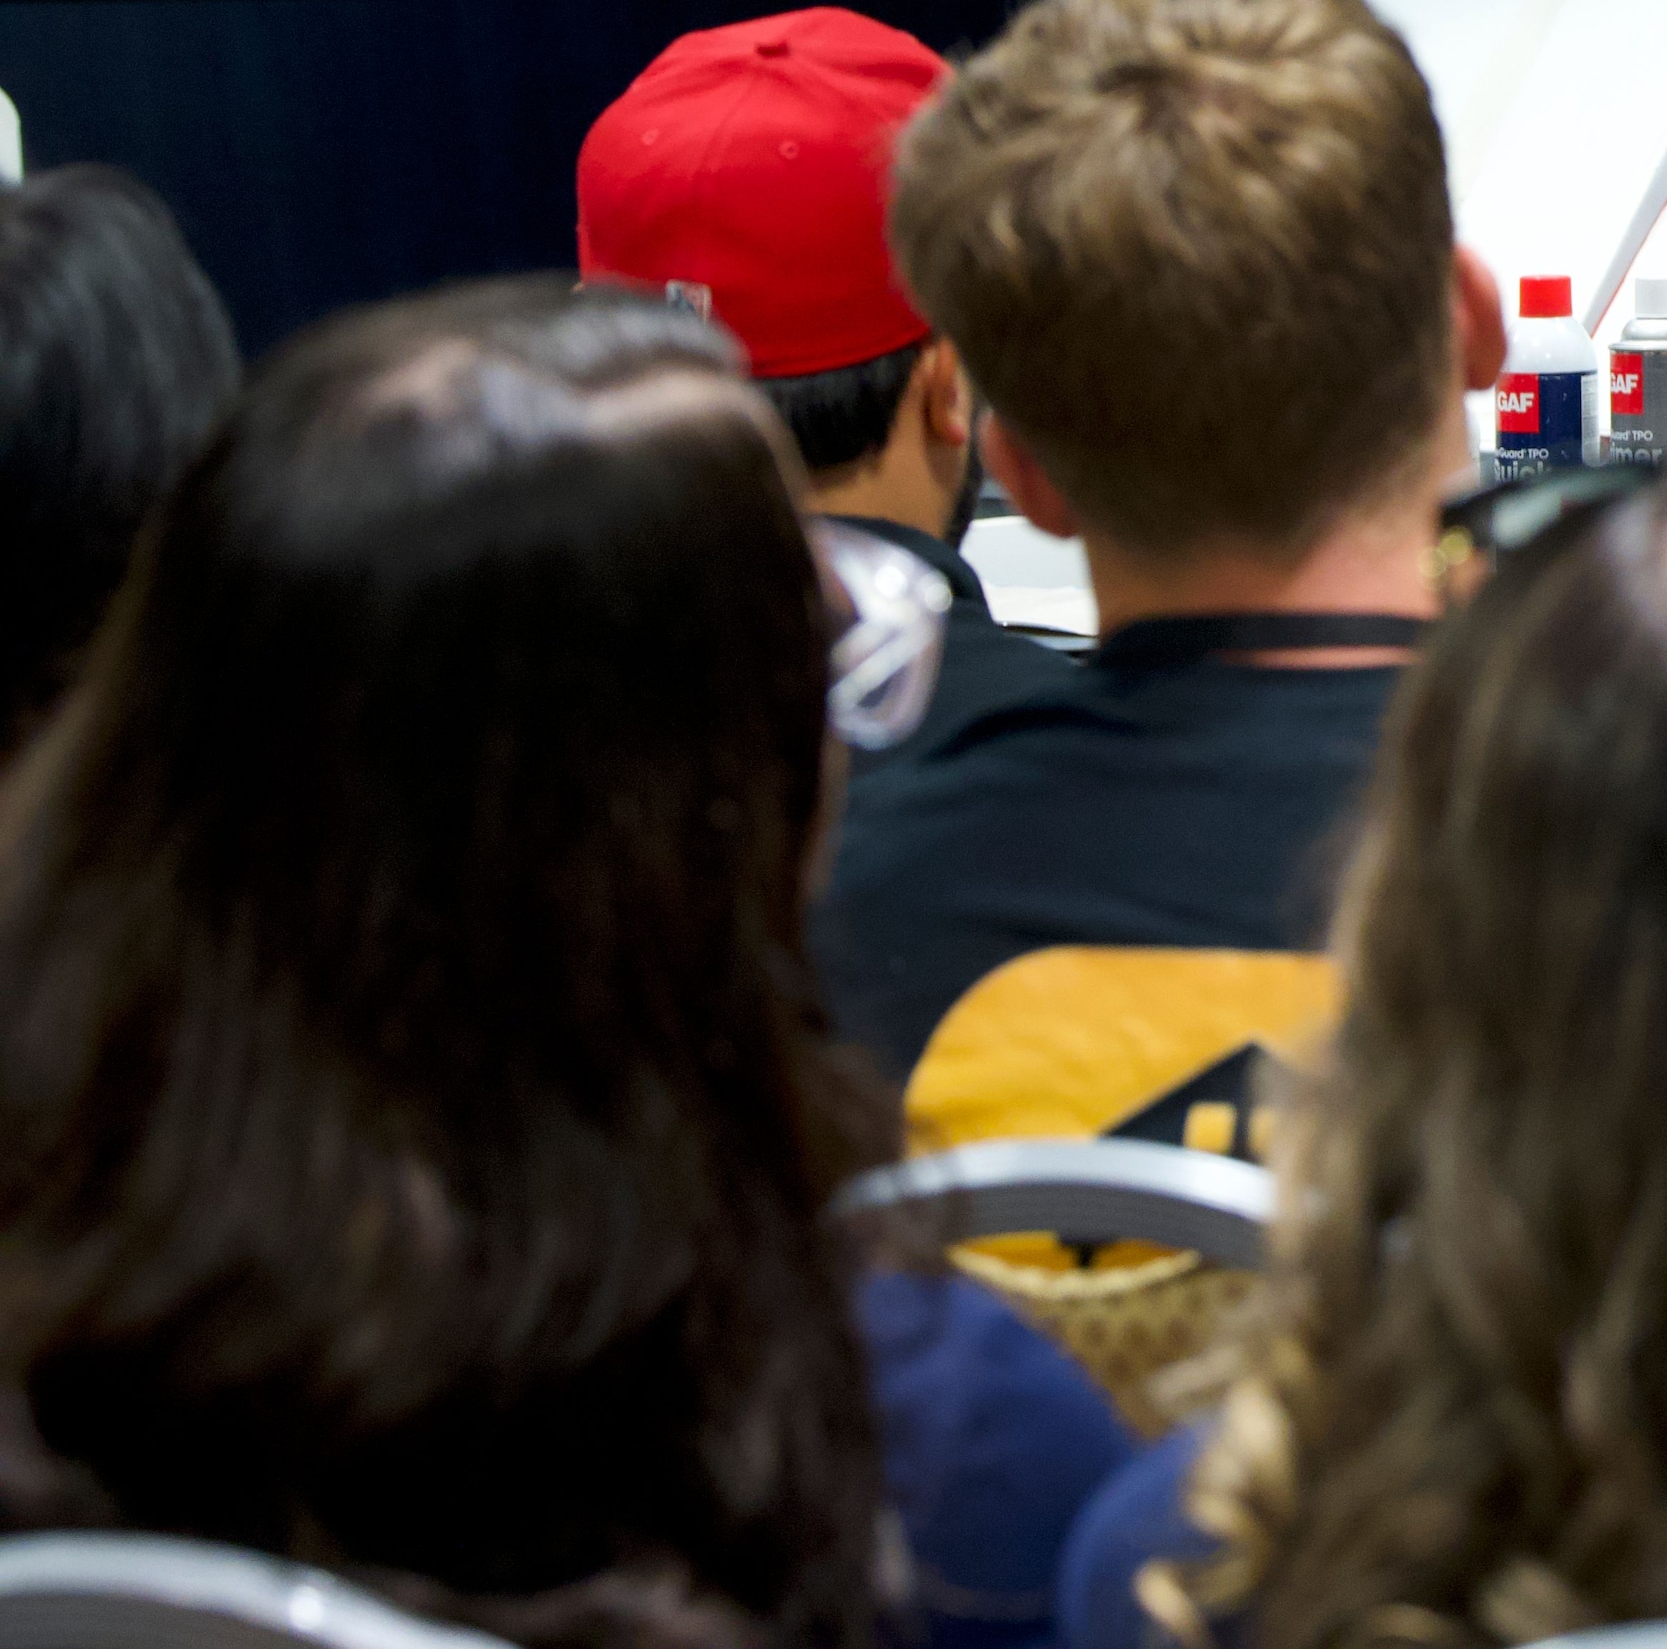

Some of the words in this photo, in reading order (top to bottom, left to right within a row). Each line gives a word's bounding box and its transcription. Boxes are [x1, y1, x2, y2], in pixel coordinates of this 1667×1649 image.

[1497, 392, 1535, 413] GAF
[1632, 430, 1653, 442] TPO
[1528, 448, 1549, 460] TPO
